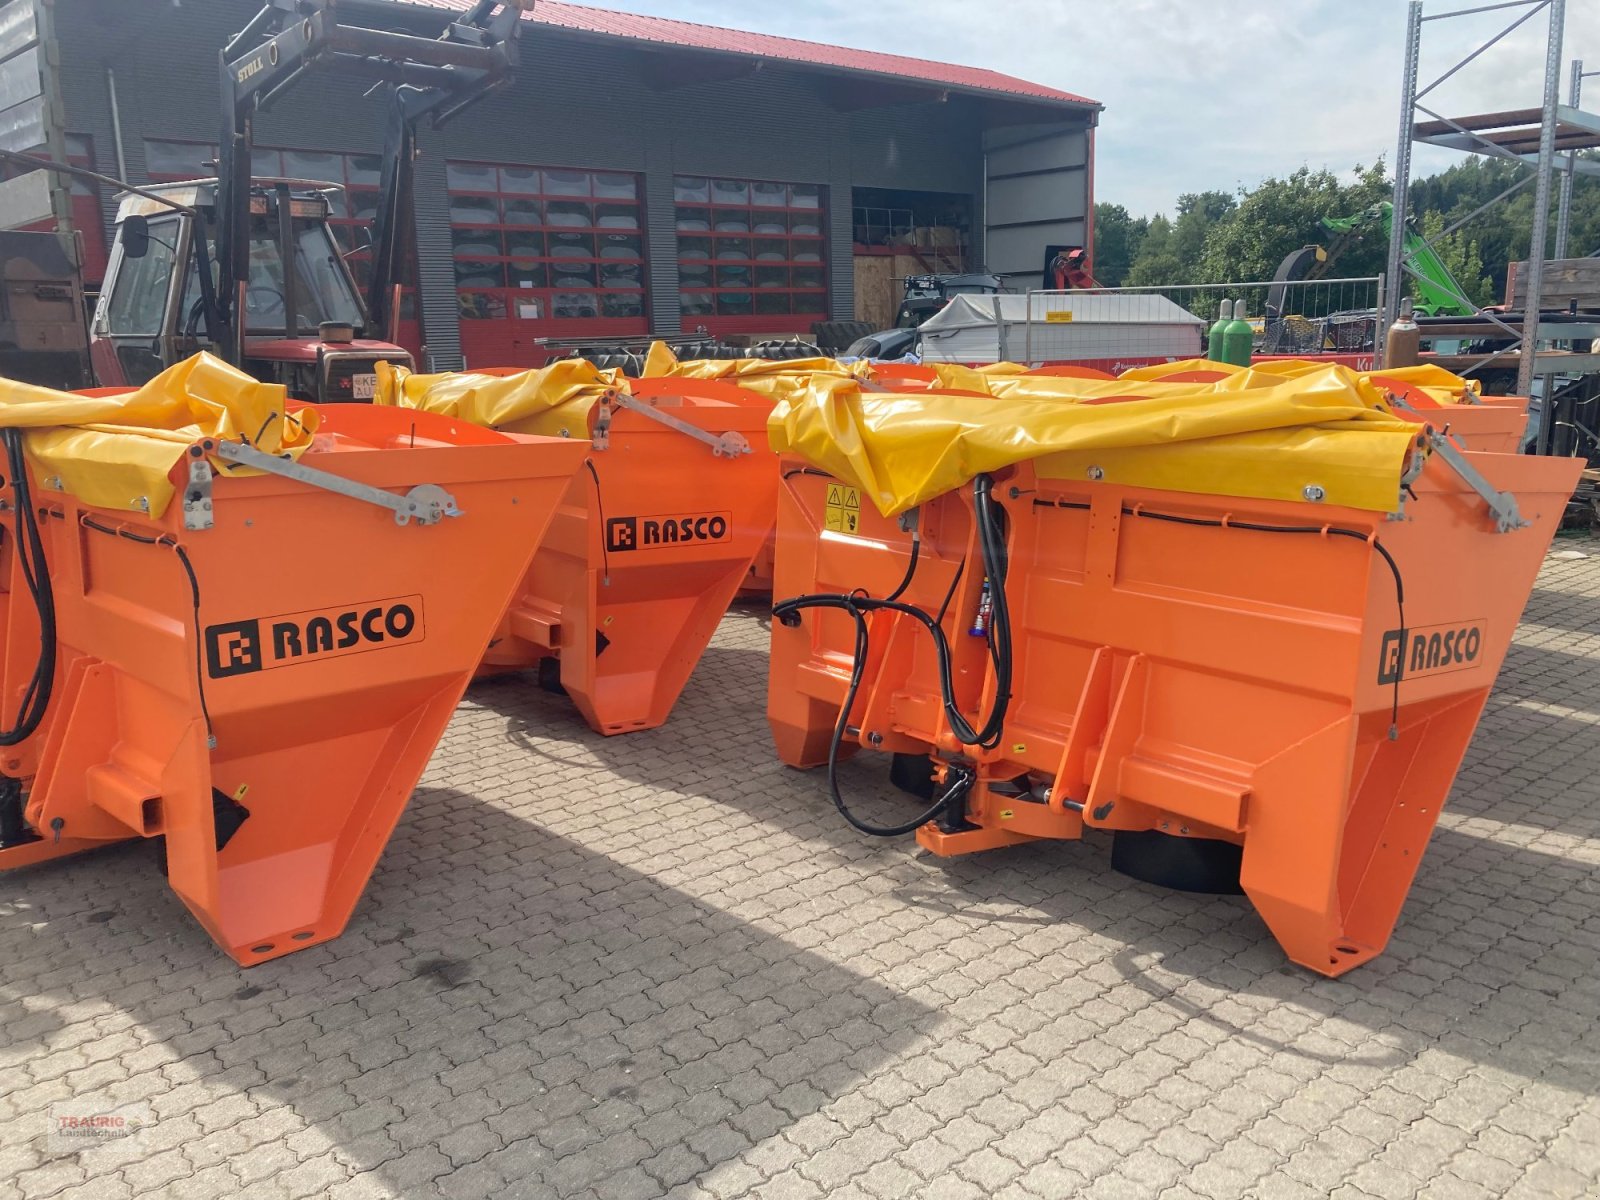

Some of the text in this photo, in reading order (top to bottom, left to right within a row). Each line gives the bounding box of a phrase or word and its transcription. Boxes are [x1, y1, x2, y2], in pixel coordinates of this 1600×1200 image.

[238, 56, 264, 83] STOLL
[644, 516, 726, 544] RASCO
[272, 604, 415, 660] RASCO
[1409, 627, 1480, 672] RASCO
